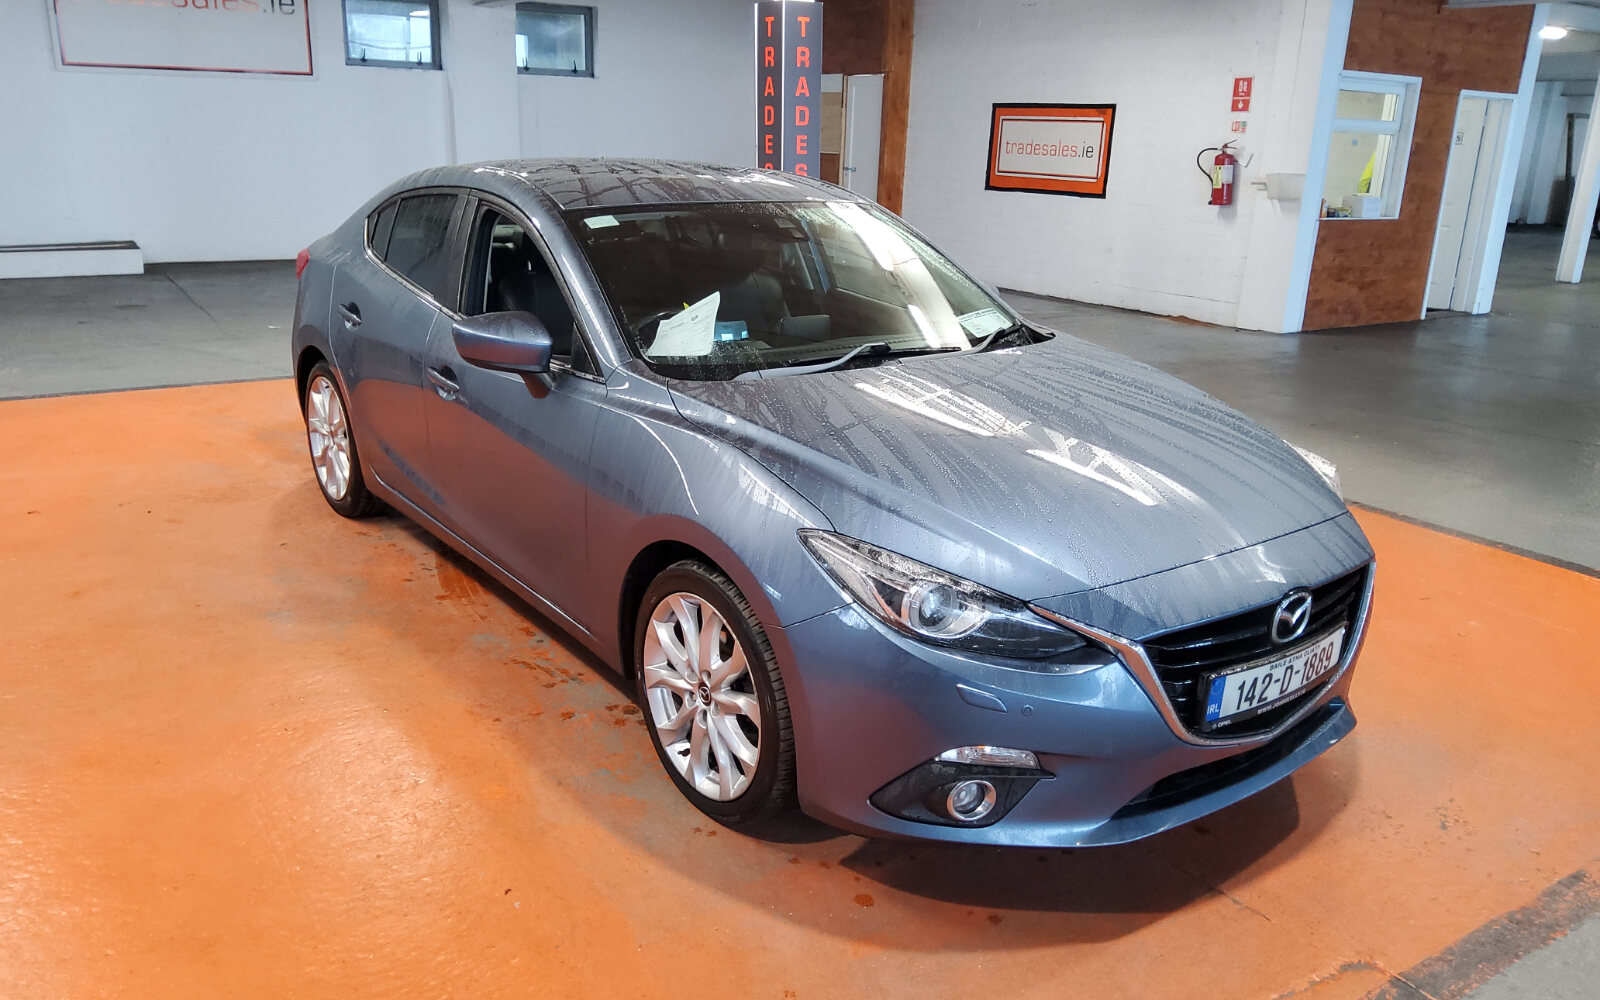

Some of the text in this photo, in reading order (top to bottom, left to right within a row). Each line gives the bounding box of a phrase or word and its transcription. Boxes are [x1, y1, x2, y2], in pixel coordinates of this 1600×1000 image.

[764, 16, 775, 170] TRADE
[1005, 139, 1094, 158] tradesales.ie
[1236, 641, 1334, 711] 142-D-1889
[1207, 703, 1219, 715] IRL
